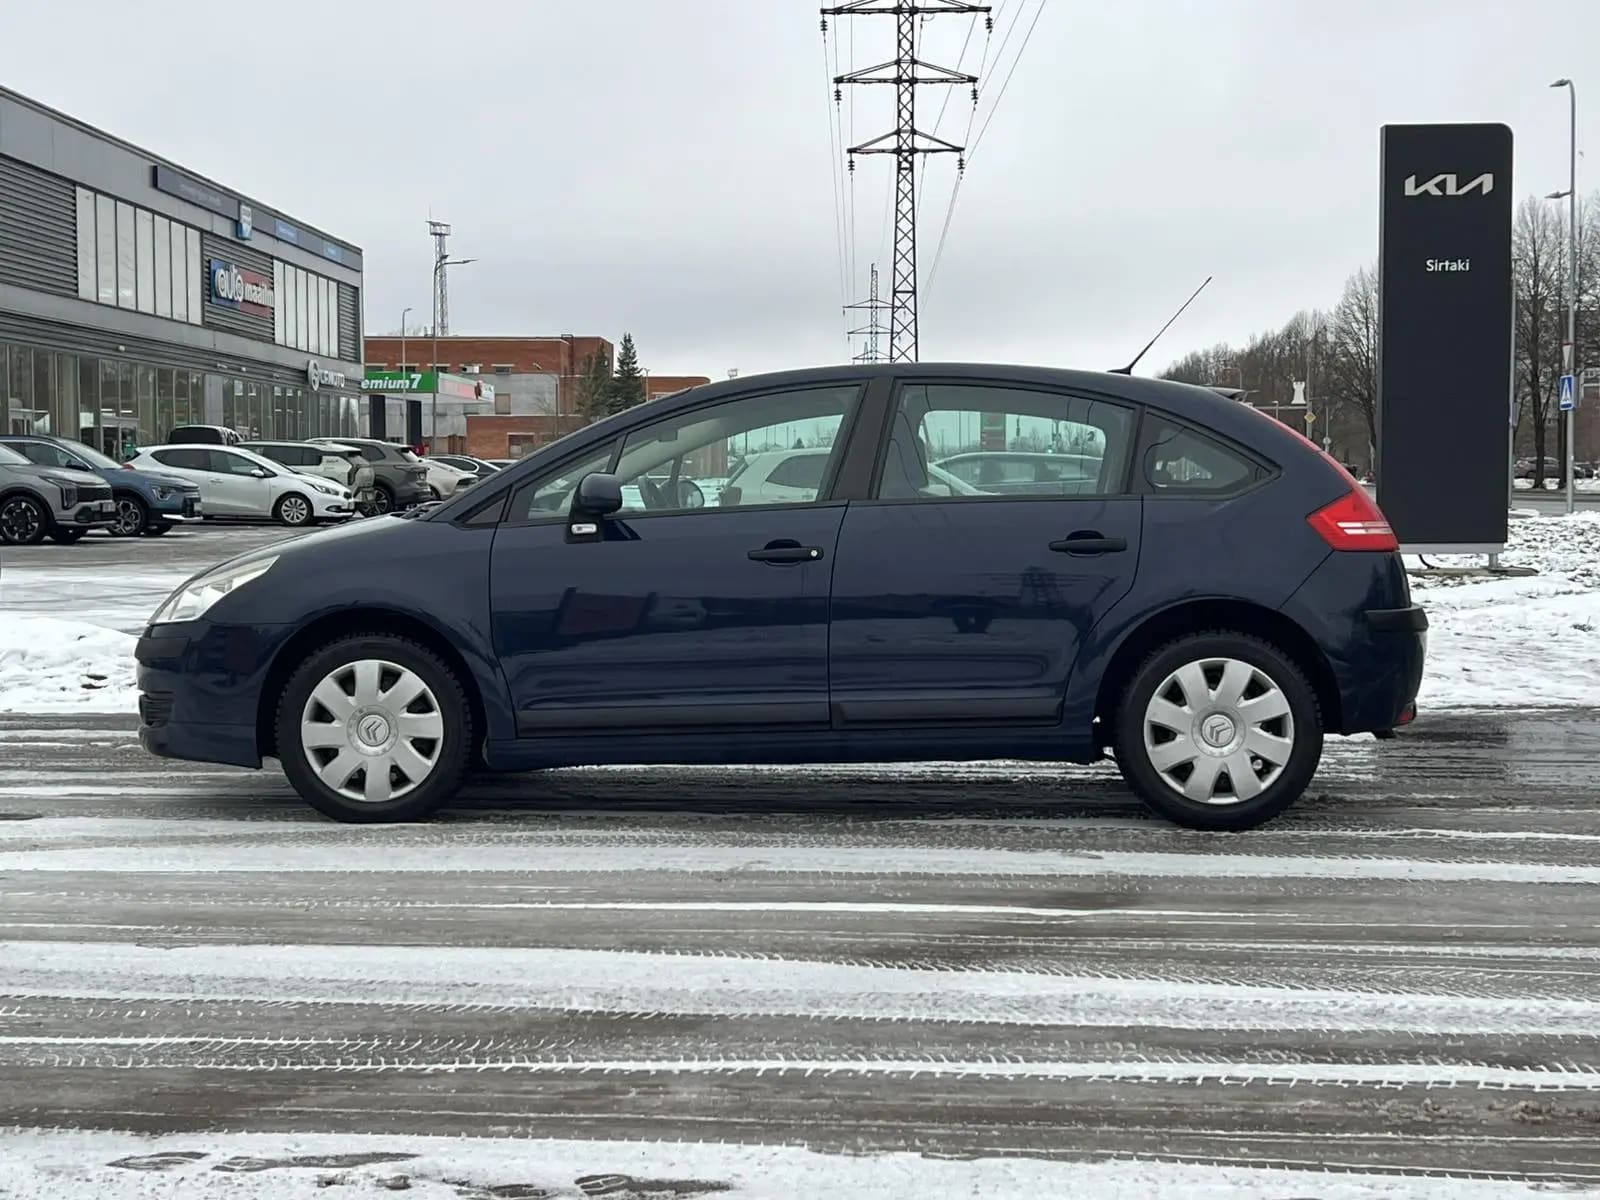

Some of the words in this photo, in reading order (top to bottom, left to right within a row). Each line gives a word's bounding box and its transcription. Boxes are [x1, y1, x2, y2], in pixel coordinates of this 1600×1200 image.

[1404, 173, 1494, 196] KIA
[1426, 259, 1470, 272] Sirtaki
[360, 373, 422, 389] emium7
